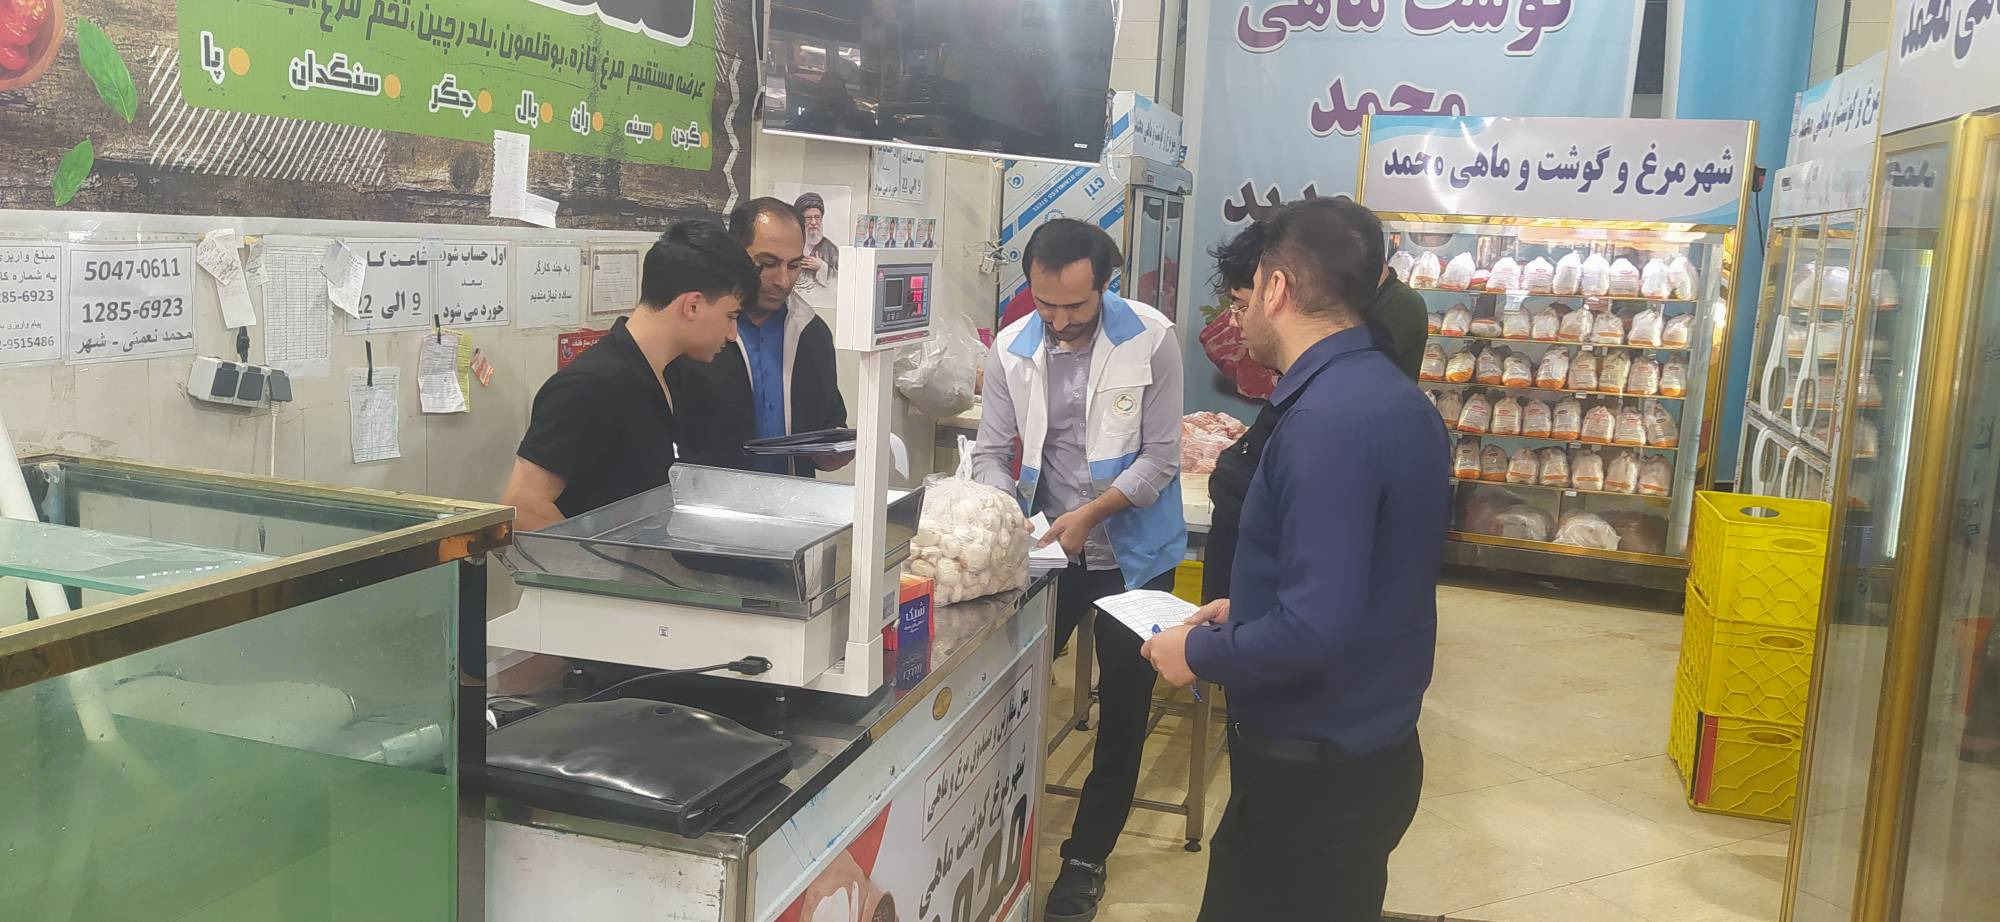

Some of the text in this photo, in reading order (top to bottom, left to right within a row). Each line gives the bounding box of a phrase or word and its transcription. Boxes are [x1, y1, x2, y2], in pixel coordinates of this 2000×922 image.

[600, 50, 625, 89] مرغ
[626, 61, 674, 95] مستقیم
[200, 30, 701, 150] گردن سینه ران بال جگر سنگدان پا
[1384, 142, 1734, 196] شهر مرغ و گوشت و ماهی محمد
[33, 250, 56, 264] مبلغ
[462, 246, 488, 264] حساب
[491, 246, 507, 266] اول
[12, 269, 42, 283] شماره
[46, 271, 57, 283] به
[84, 257, 181, 282] 5047-0611
[461, 278, 483, 289] بعد
[0, 289, 55, 304] 85-6923
[381, 290, 406, 319] الی
[412, 292, 421, 311] 9
[82, 297, 184, 323] 1285-6923
[443, 300, 504, 323] خورد می شود
[0, 335, 55, 351] -9515486
[75, 332, 107, 354] شهر
[122, 328, 158, 352] نعمتی
[162, 329, 193, 343] محمد
[919, 833, 953, 920] ماهی
